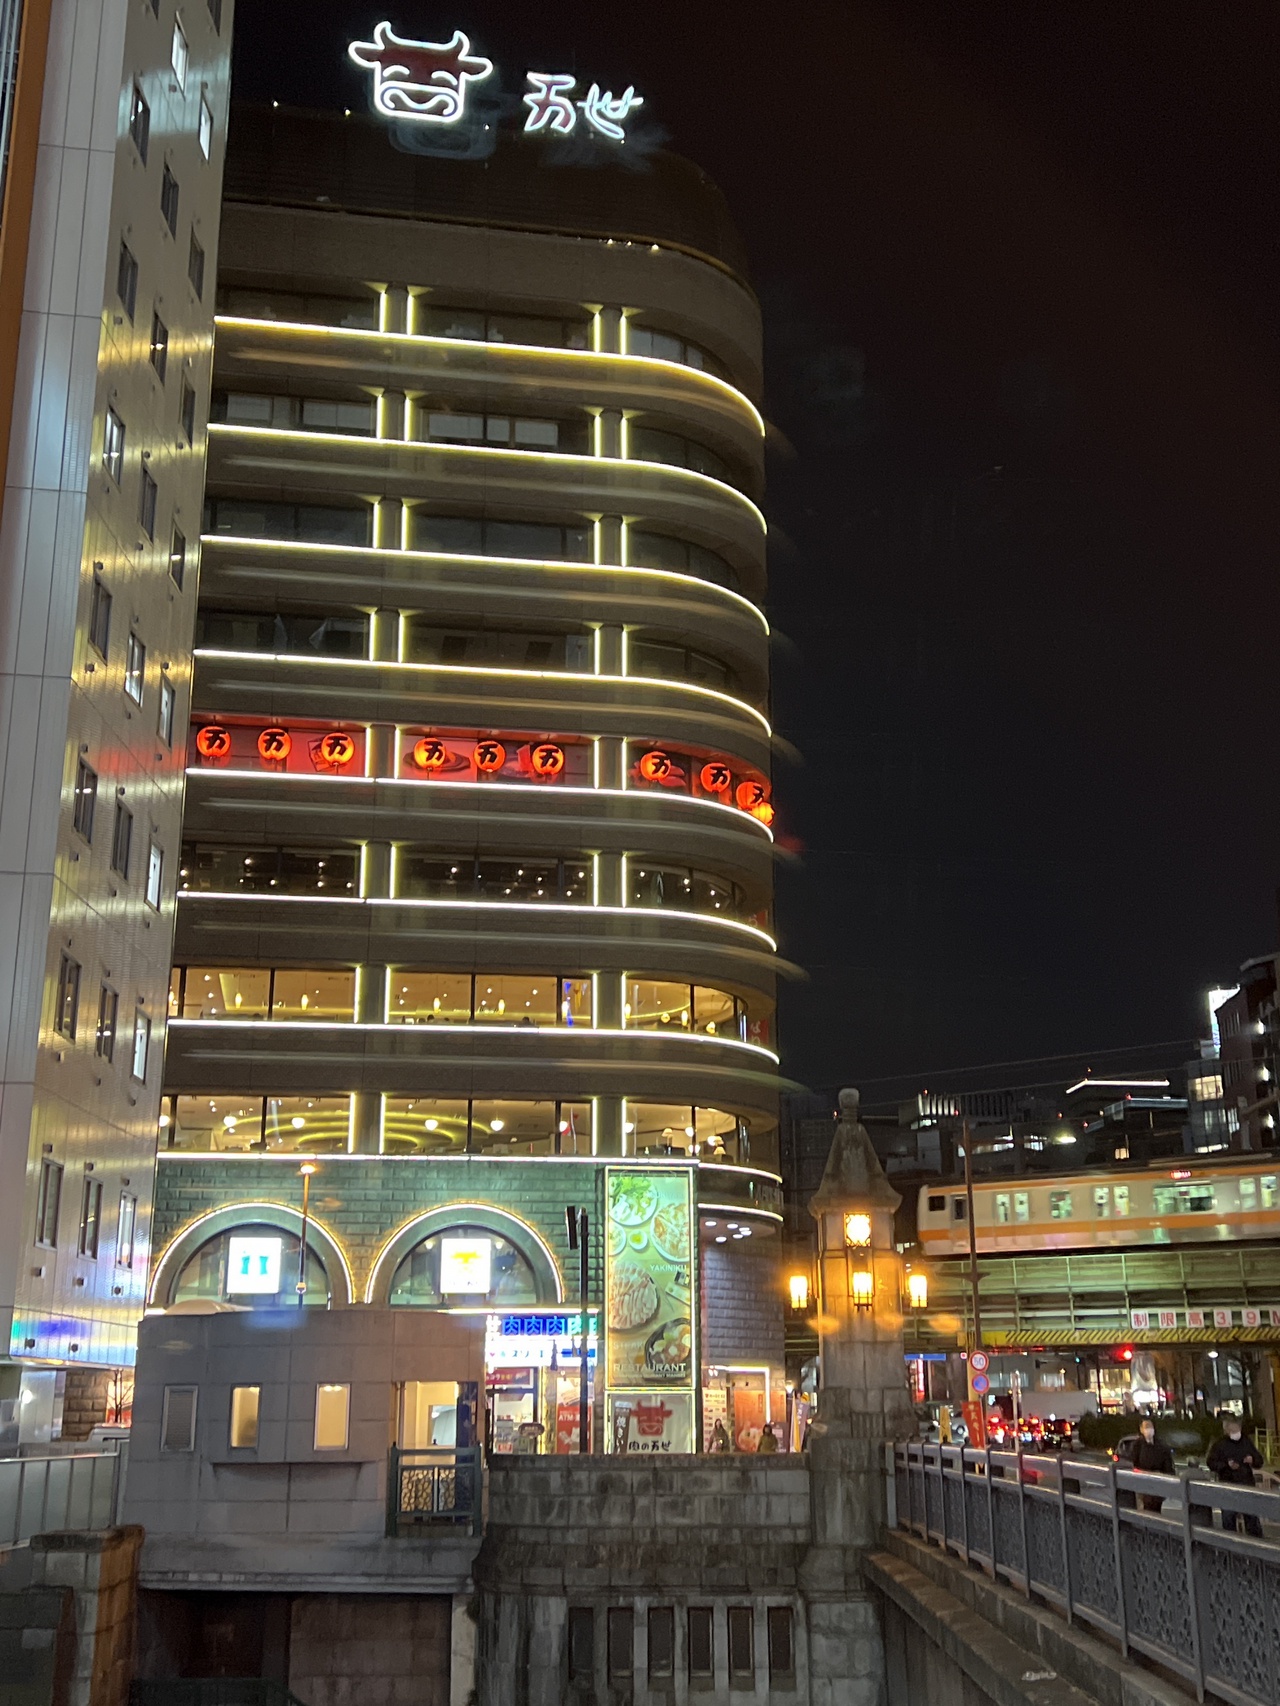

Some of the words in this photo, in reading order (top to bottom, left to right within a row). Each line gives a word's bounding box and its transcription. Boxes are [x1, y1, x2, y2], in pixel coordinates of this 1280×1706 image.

[205, 728, 227, 750] 万
[265, 731, 286, 753] 万
[325, 734, 348, 757] 万
[424, 740, 446, 762] 万
[477, 743, 499, 765] 万
[539, 748, 560, 770] 万
[651, 754, 670, 775] 万
[710, 765, 729, 786] 万
[650, 1264, 687, 1272] YAKINIKU
[613, 1363, 686, 1372] RESTAURANT
[628, 1440, 672, 1452] 肉の万世
